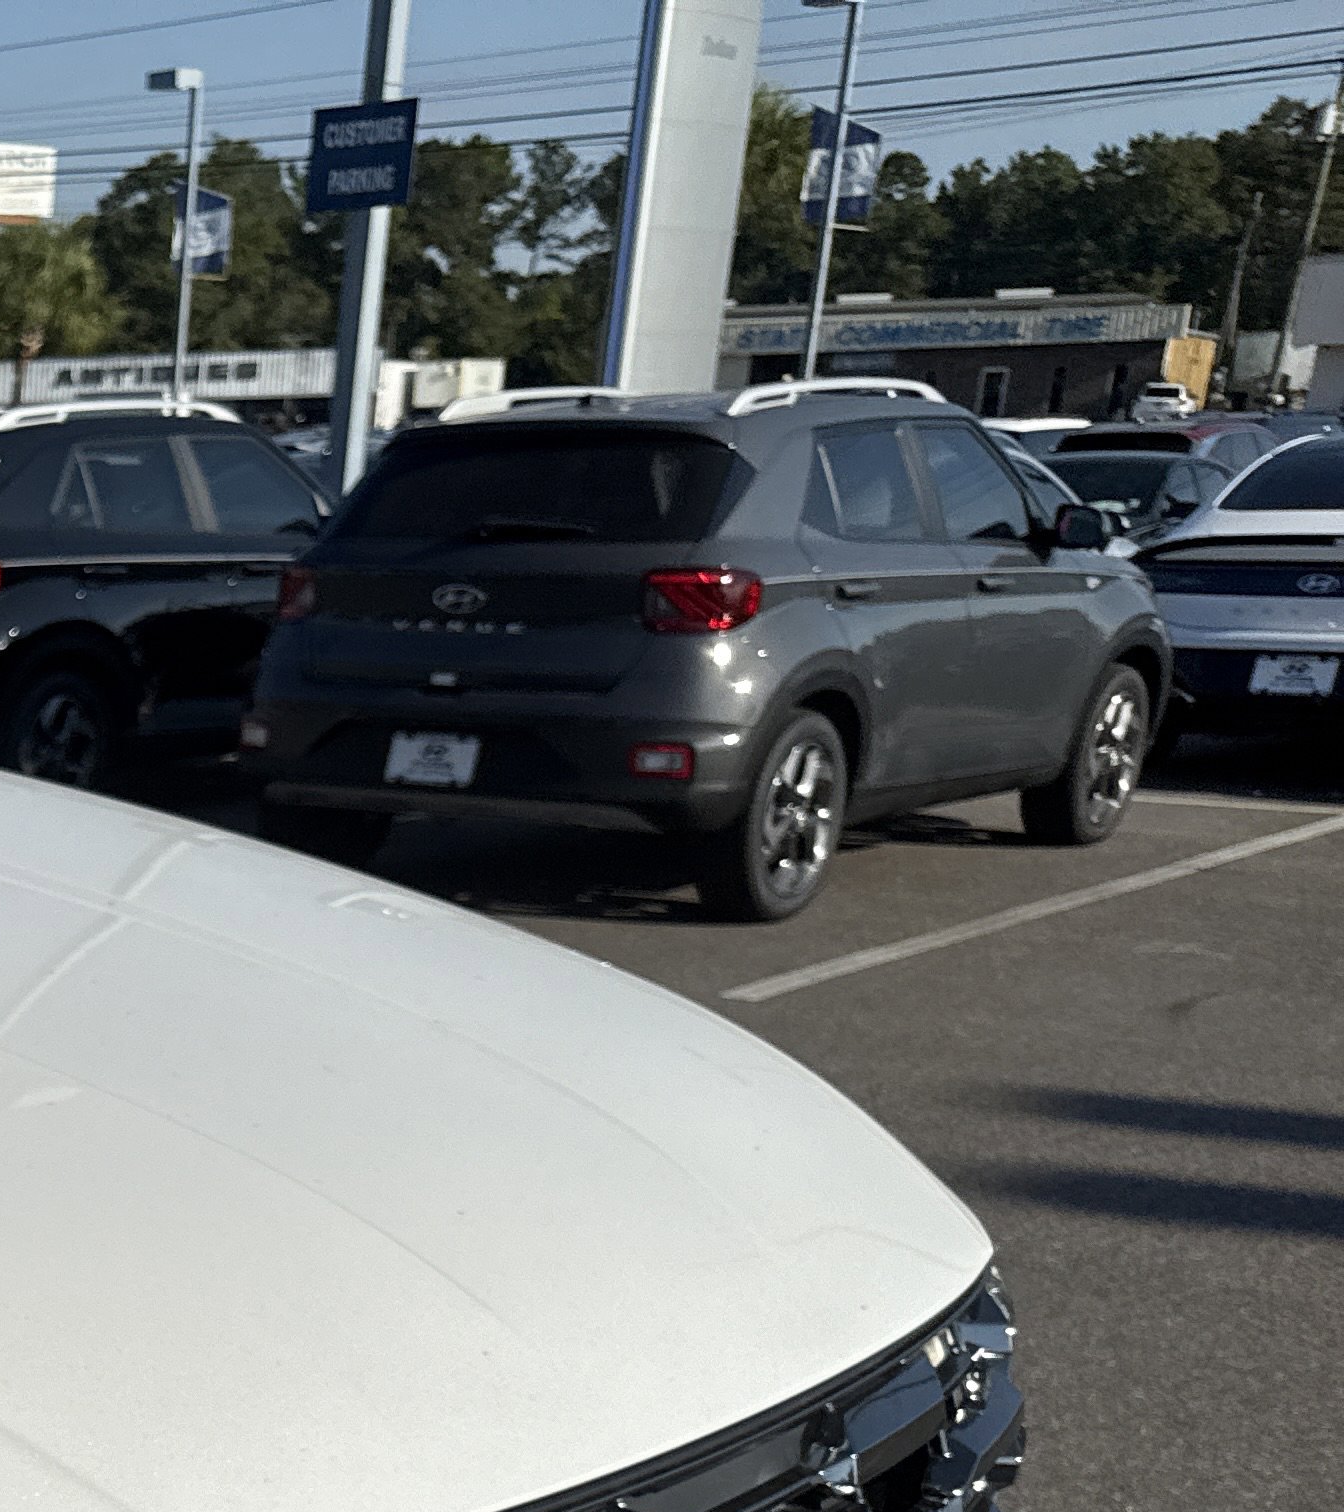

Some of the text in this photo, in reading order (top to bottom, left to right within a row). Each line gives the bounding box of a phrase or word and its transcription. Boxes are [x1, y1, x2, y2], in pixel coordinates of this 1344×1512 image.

[323, 116, 407, 148] CUSTOMER
[327, 164, 395, 195] PARKING
[835, 319, 1025, 347] COMMERCIAL
[392, 618, 527, 635] VENUE
